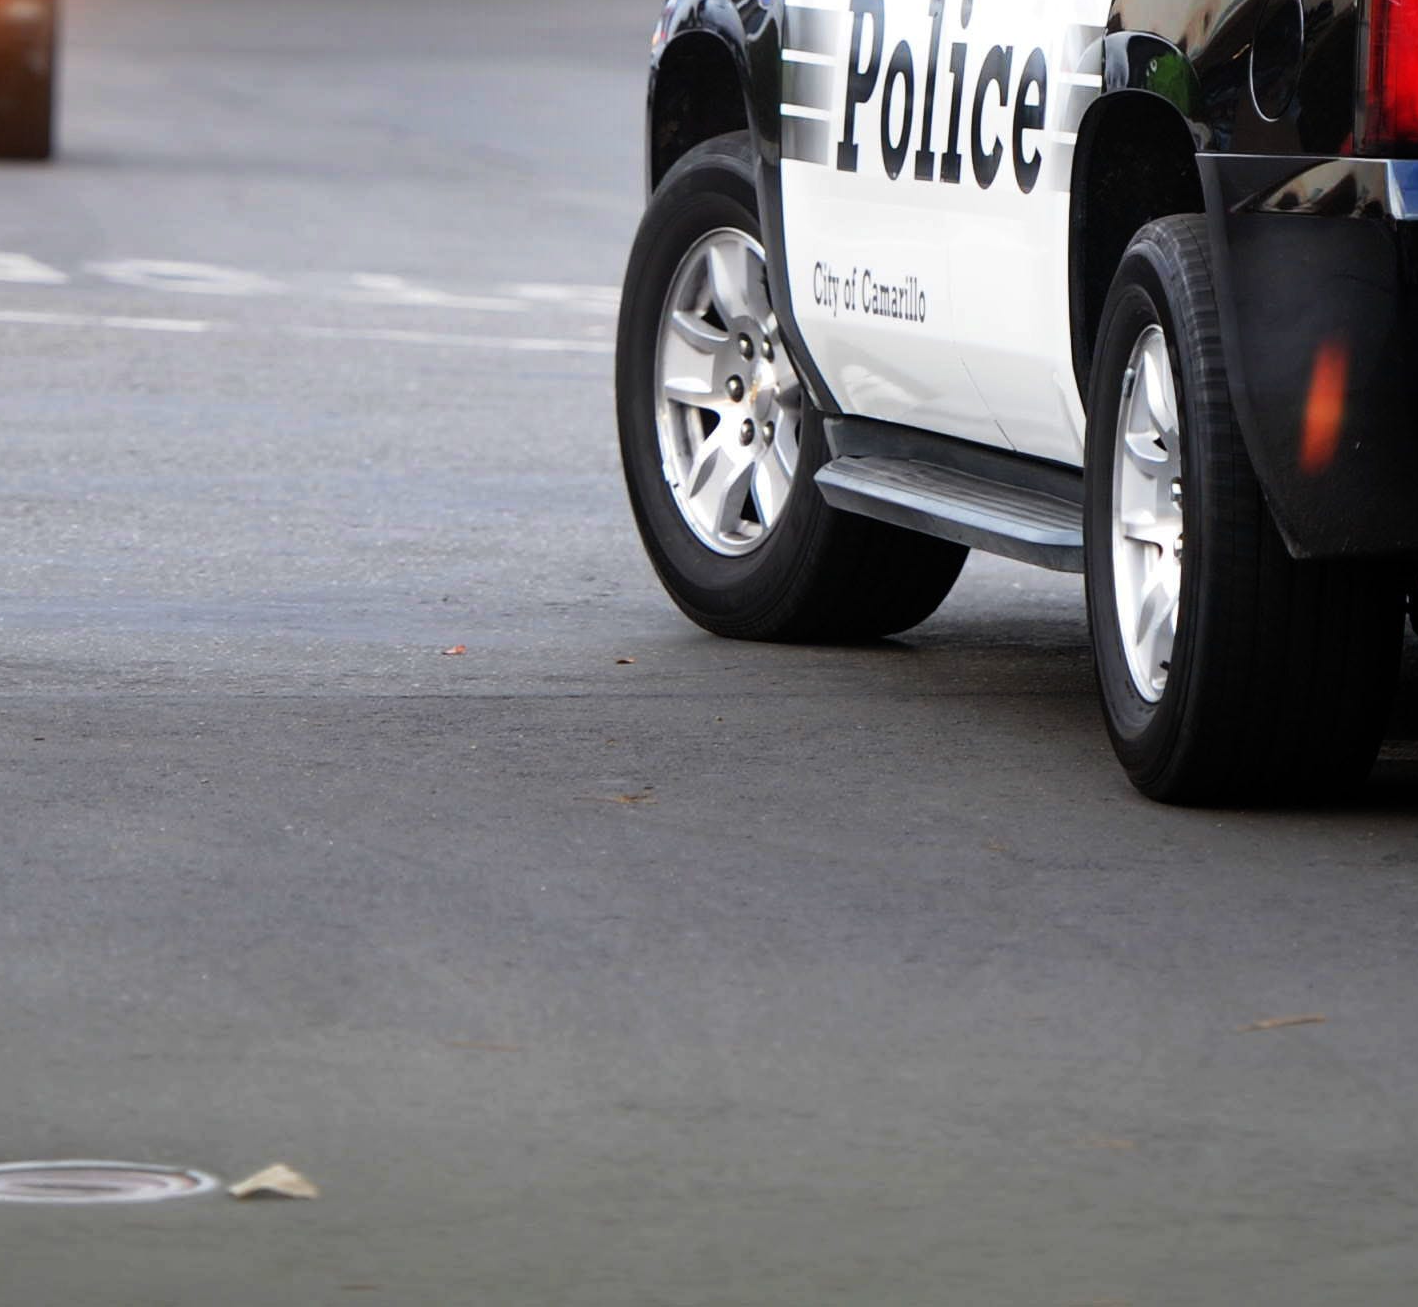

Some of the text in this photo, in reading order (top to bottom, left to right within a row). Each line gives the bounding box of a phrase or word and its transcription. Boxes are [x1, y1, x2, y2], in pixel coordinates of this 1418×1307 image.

[813, 261, 926, 323] City of Camarillo
